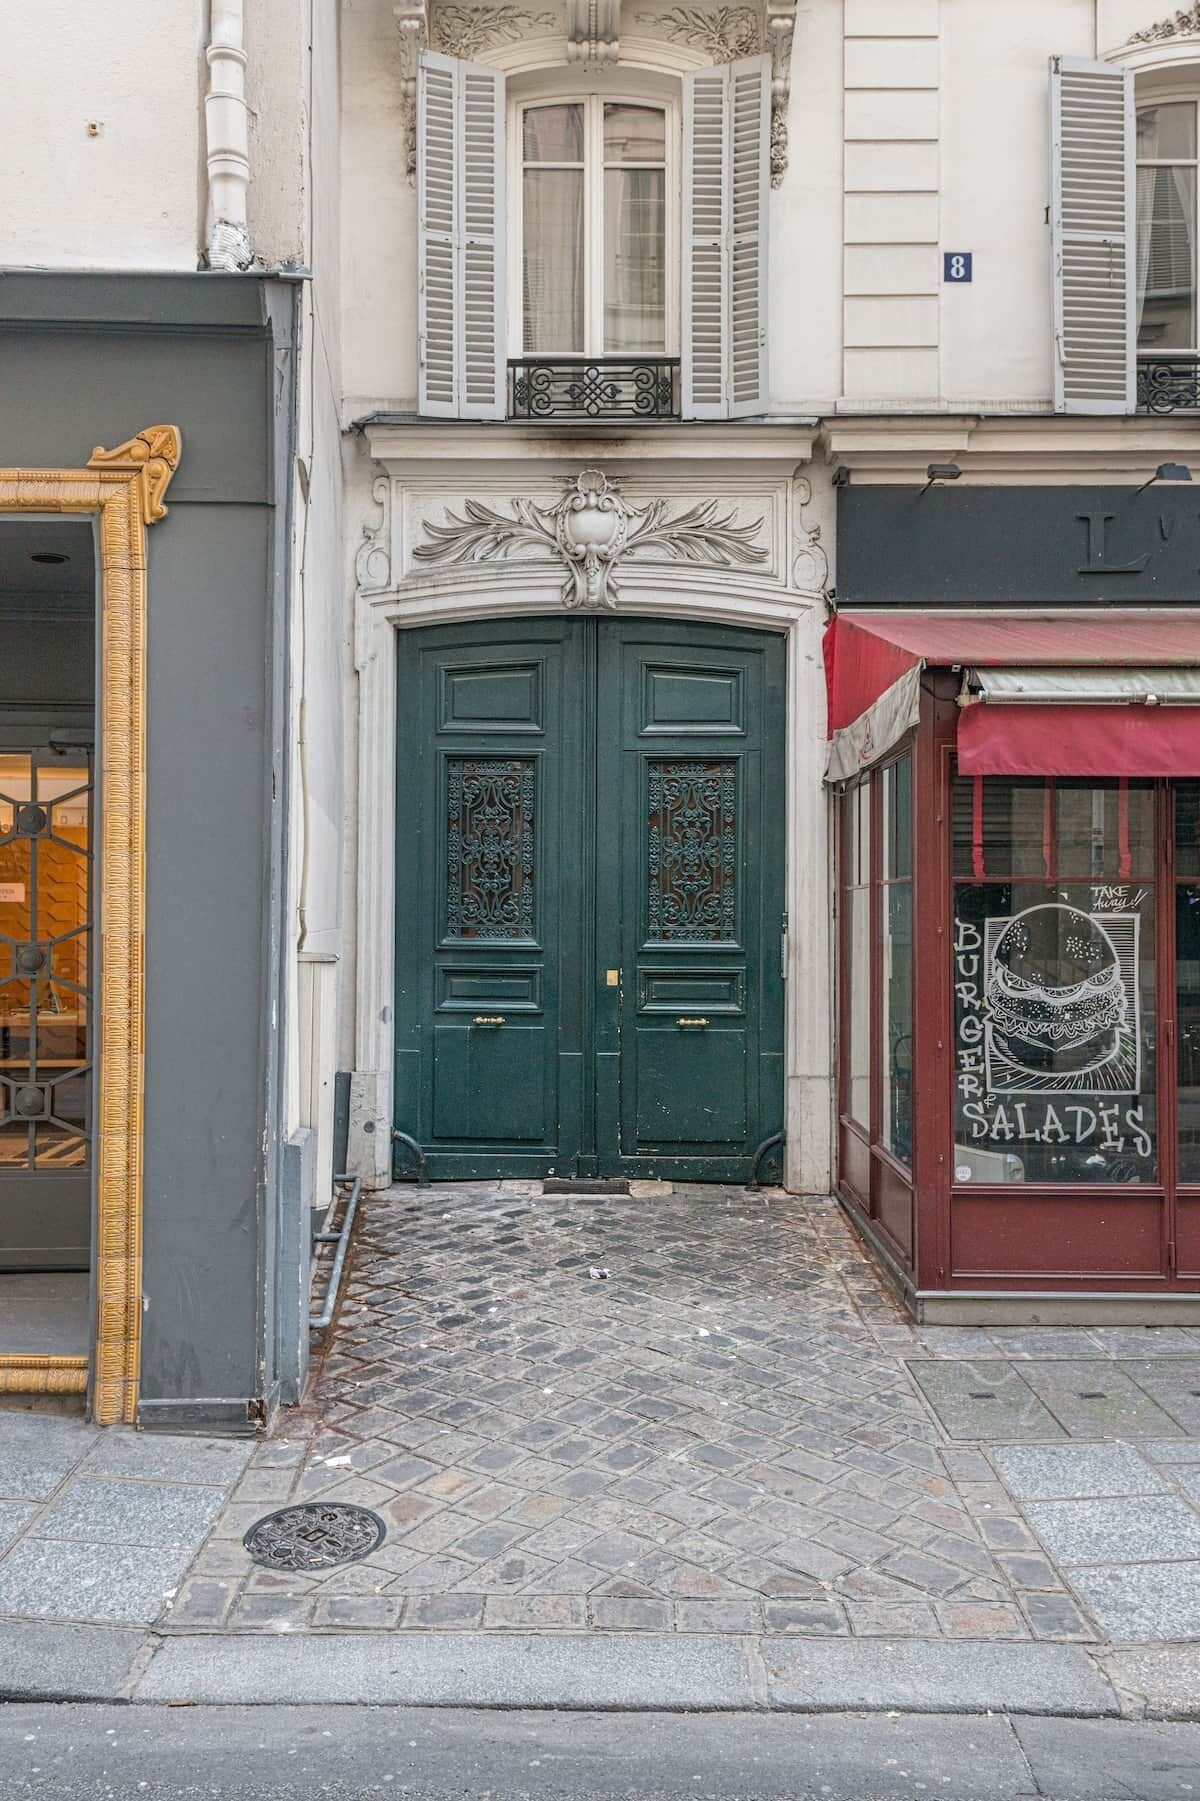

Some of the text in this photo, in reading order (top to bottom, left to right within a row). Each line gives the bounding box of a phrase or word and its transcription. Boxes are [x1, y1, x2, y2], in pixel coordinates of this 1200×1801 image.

[950, 255, 966, 279] 8
[1075, 512, 1200, 576] L'
[1089, 885, 1131, 899] TAKE
